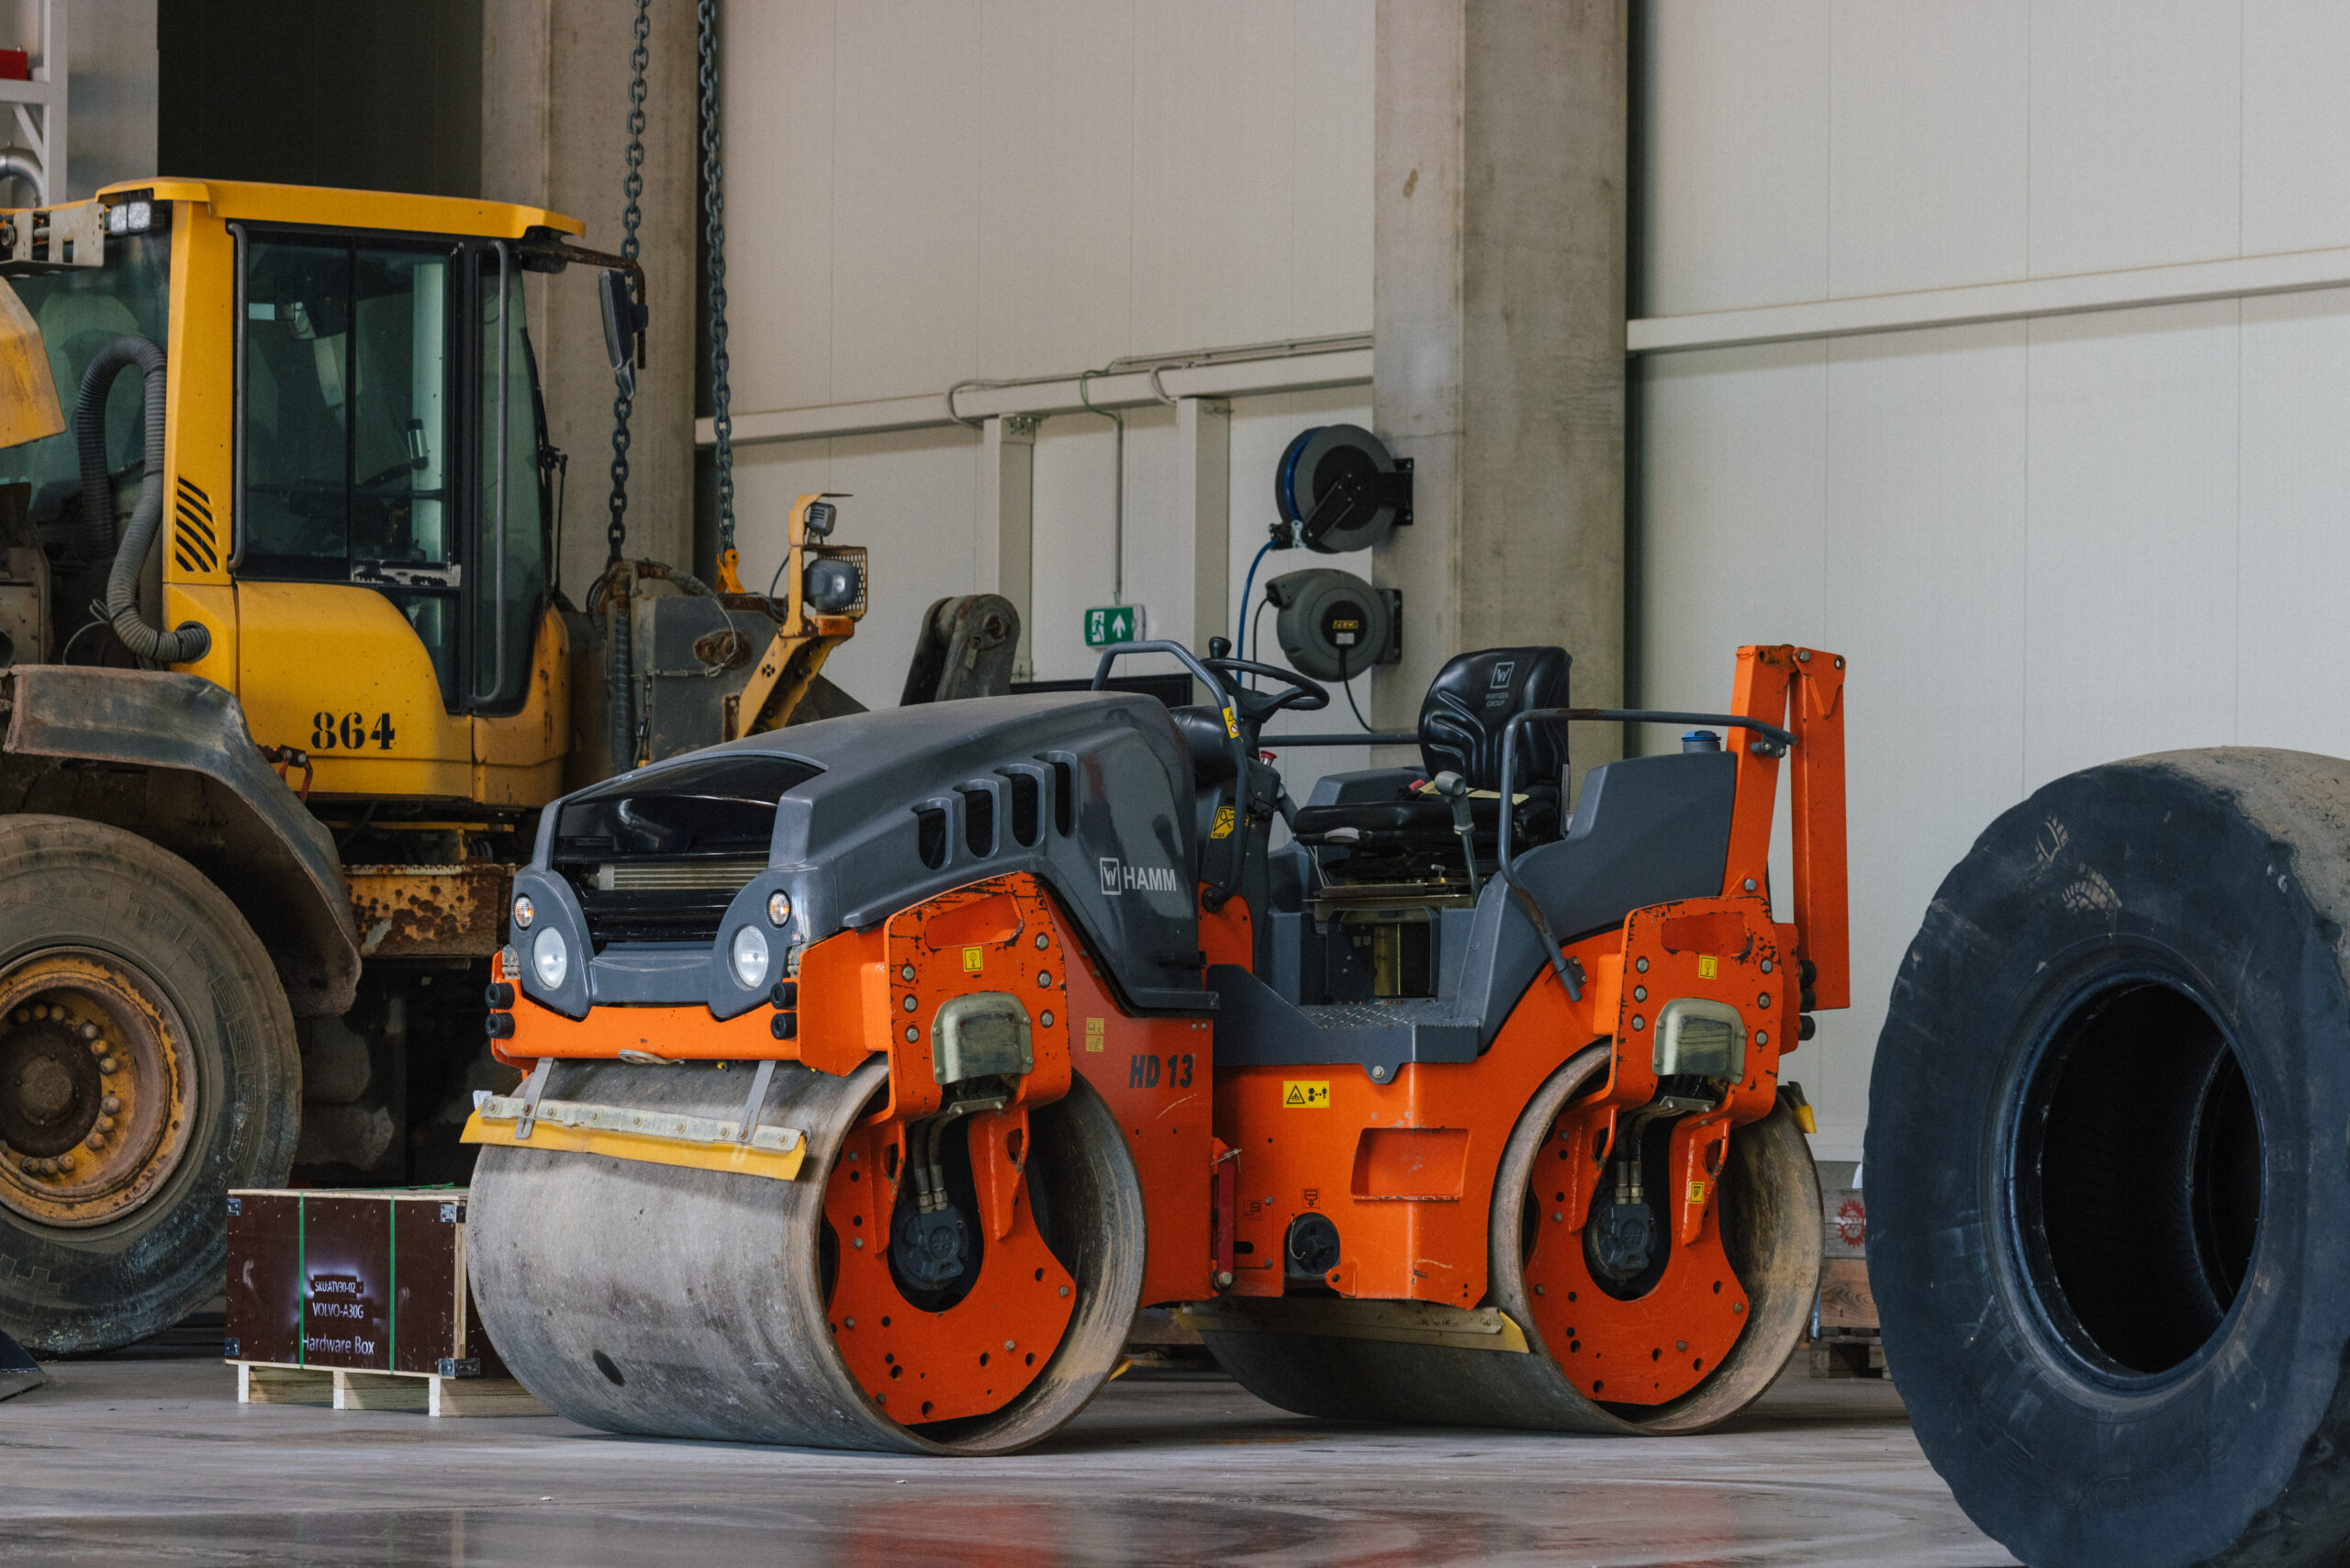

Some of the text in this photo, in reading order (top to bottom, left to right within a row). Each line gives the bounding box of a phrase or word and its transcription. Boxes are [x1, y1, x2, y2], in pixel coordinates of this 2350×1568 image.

[311, 711, 395, 749] 864
[1123, 866, 1177, 891] HAMM
[1129, 1054, 1193, 1089] HD 13
[312, 1302, 364, 1319] VOLVO-A30G
[302, 1333, 375, 1355] Hardware Box
